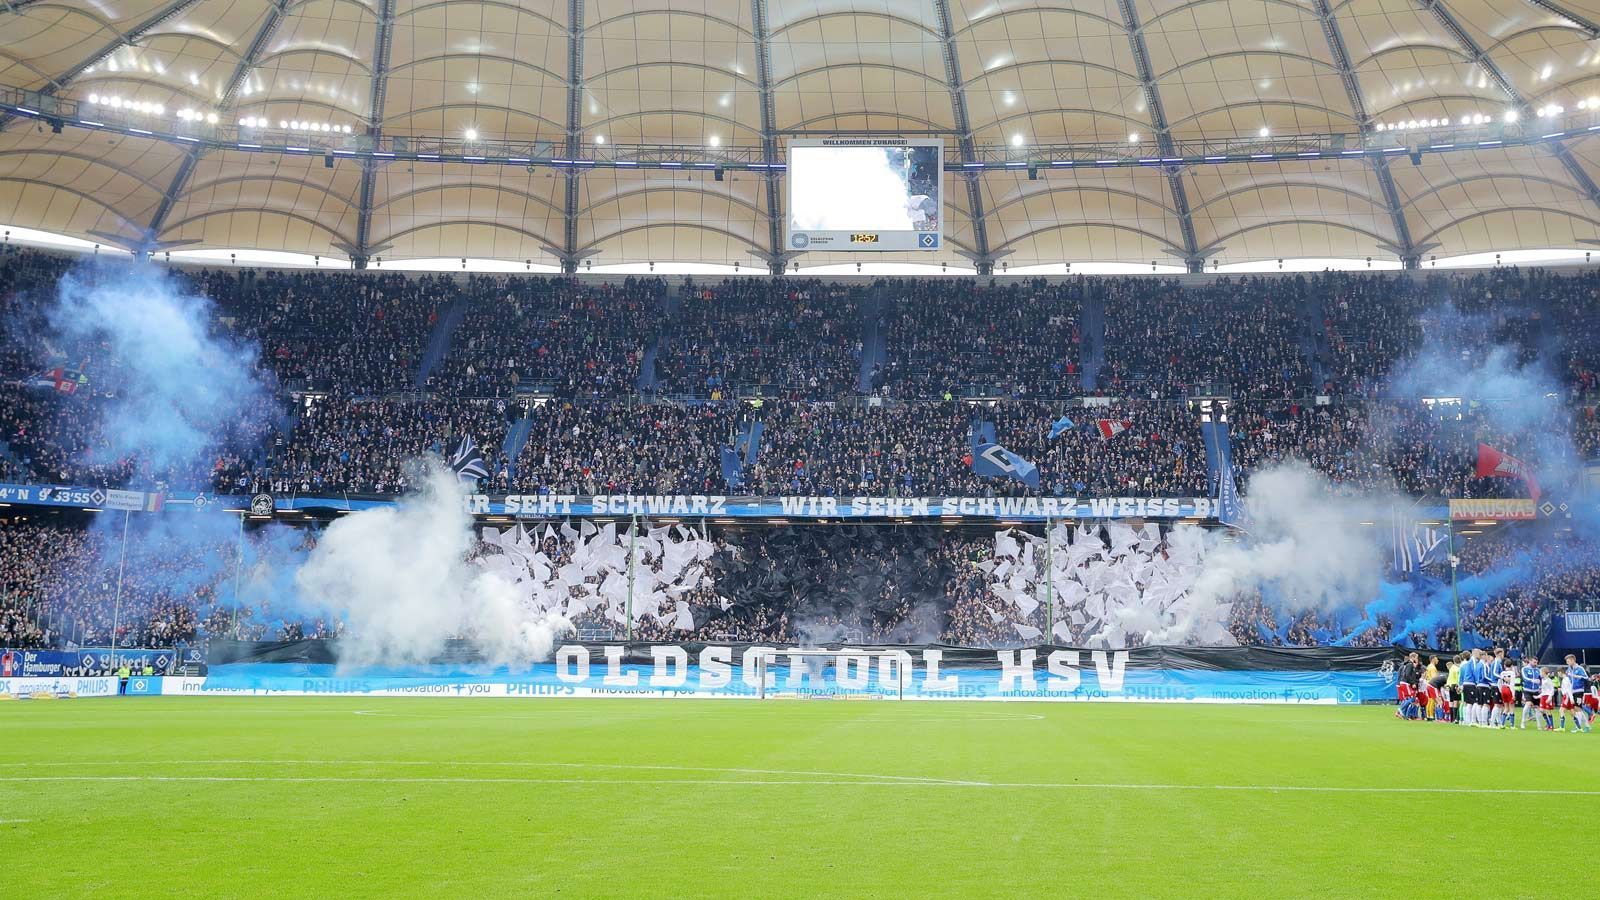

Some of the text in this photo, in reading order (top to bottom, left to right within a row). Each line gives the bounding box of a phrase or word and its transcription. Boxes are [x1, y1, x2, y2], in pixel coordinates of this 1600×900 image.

[17, 488, 30, 501] N
[505, 495, 575, 514] SEHT
[592, 495, 726, 514] SCHWARZ
[780, 496, 837, 515] WIR
[852, 497, 929, 515] SEH'N
[24, 652, 38, 662] Der
[24, 661, 61, 675] Hamburger
[997, 648, 1130, 691] HSV
[77, 679, 109, 694] PHILIPS
[468, 684, 491, 695] you
[1213, 688, 1319, 704] innovation you
